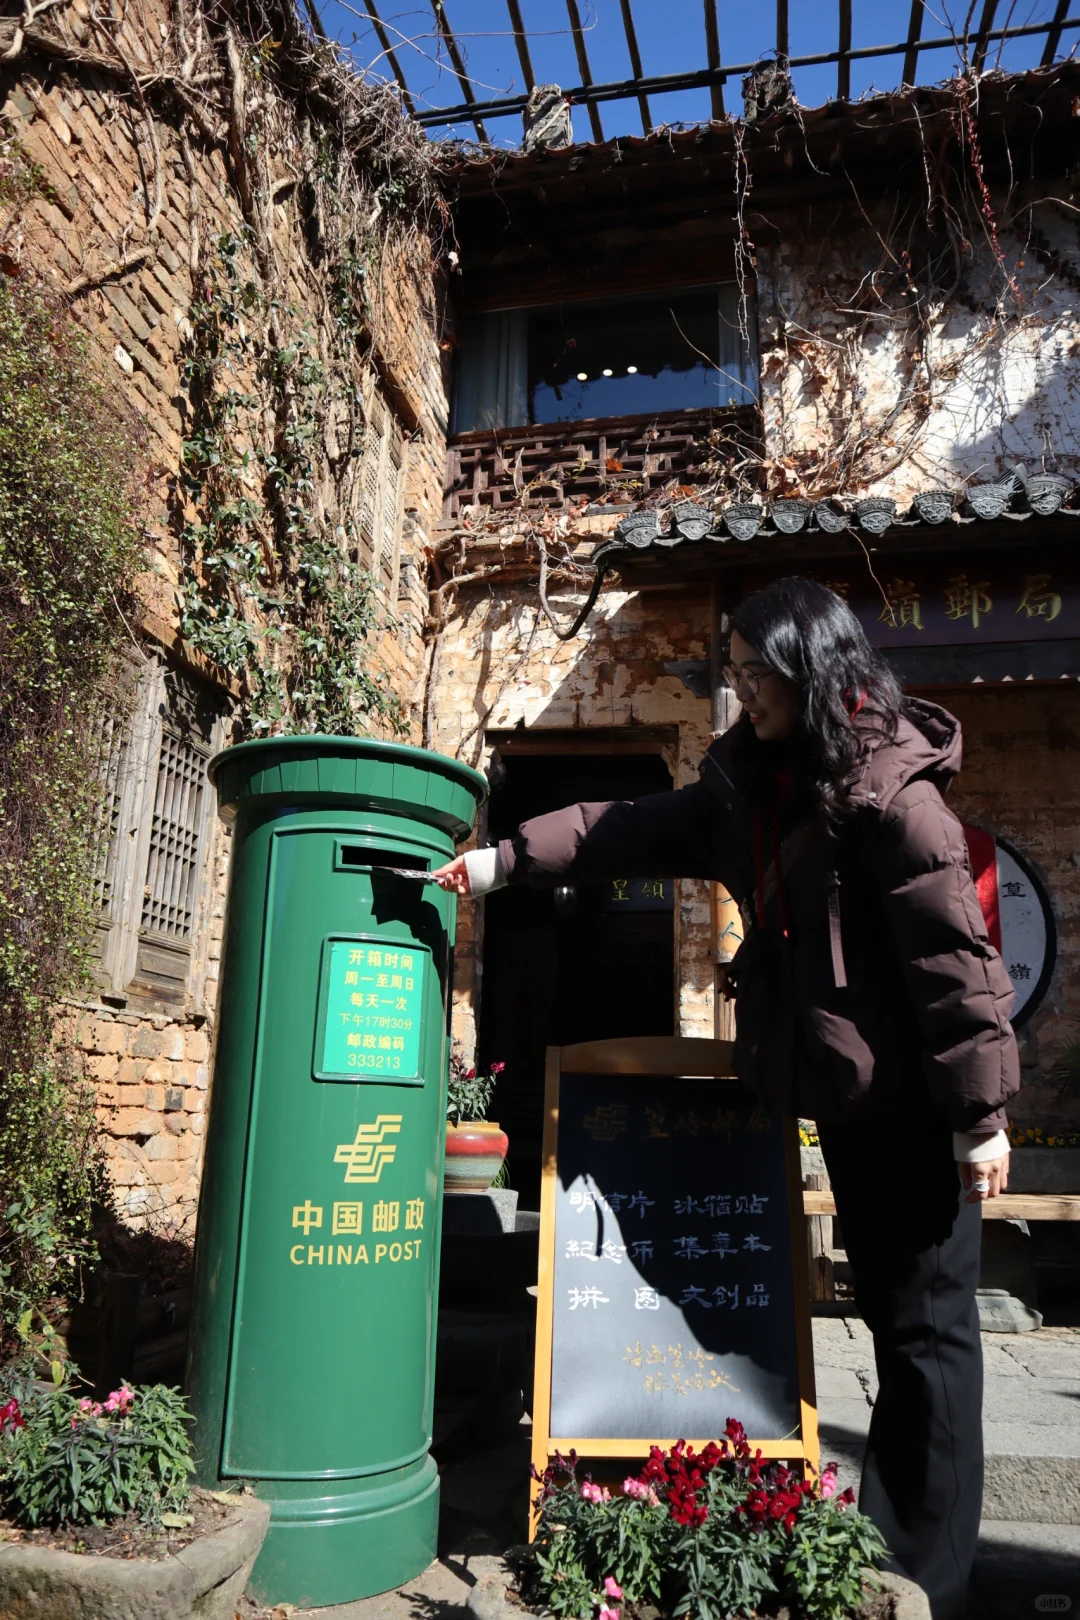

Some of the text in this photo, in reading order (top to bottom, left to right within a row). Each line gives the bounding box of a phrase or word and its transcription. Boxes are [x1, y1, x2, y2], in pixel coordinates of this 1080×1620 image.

[825, 574, 1062, 631] 嶺郵局
[348, 949, 413, 971] 开箱时间
[344, 971, 414, 991] 周一至周日
[350, 992, 407, 1011] 每天一次
[339, 1012, 413, 1031] 下午17时30分
[347, 1032, 404, 1051] 邮政编码
[347, 1053, 401, 1069] 333213
[569, 1189, 769, 1219] 明信片 冰箱贴
[292, 1197, 425, 1236] 中国邮政
[290, 1239, 422, 1266] CHINA POST
[673, 1231, 773, 1260] 集章本
[679, 1284, 770, 1310] 文创品
